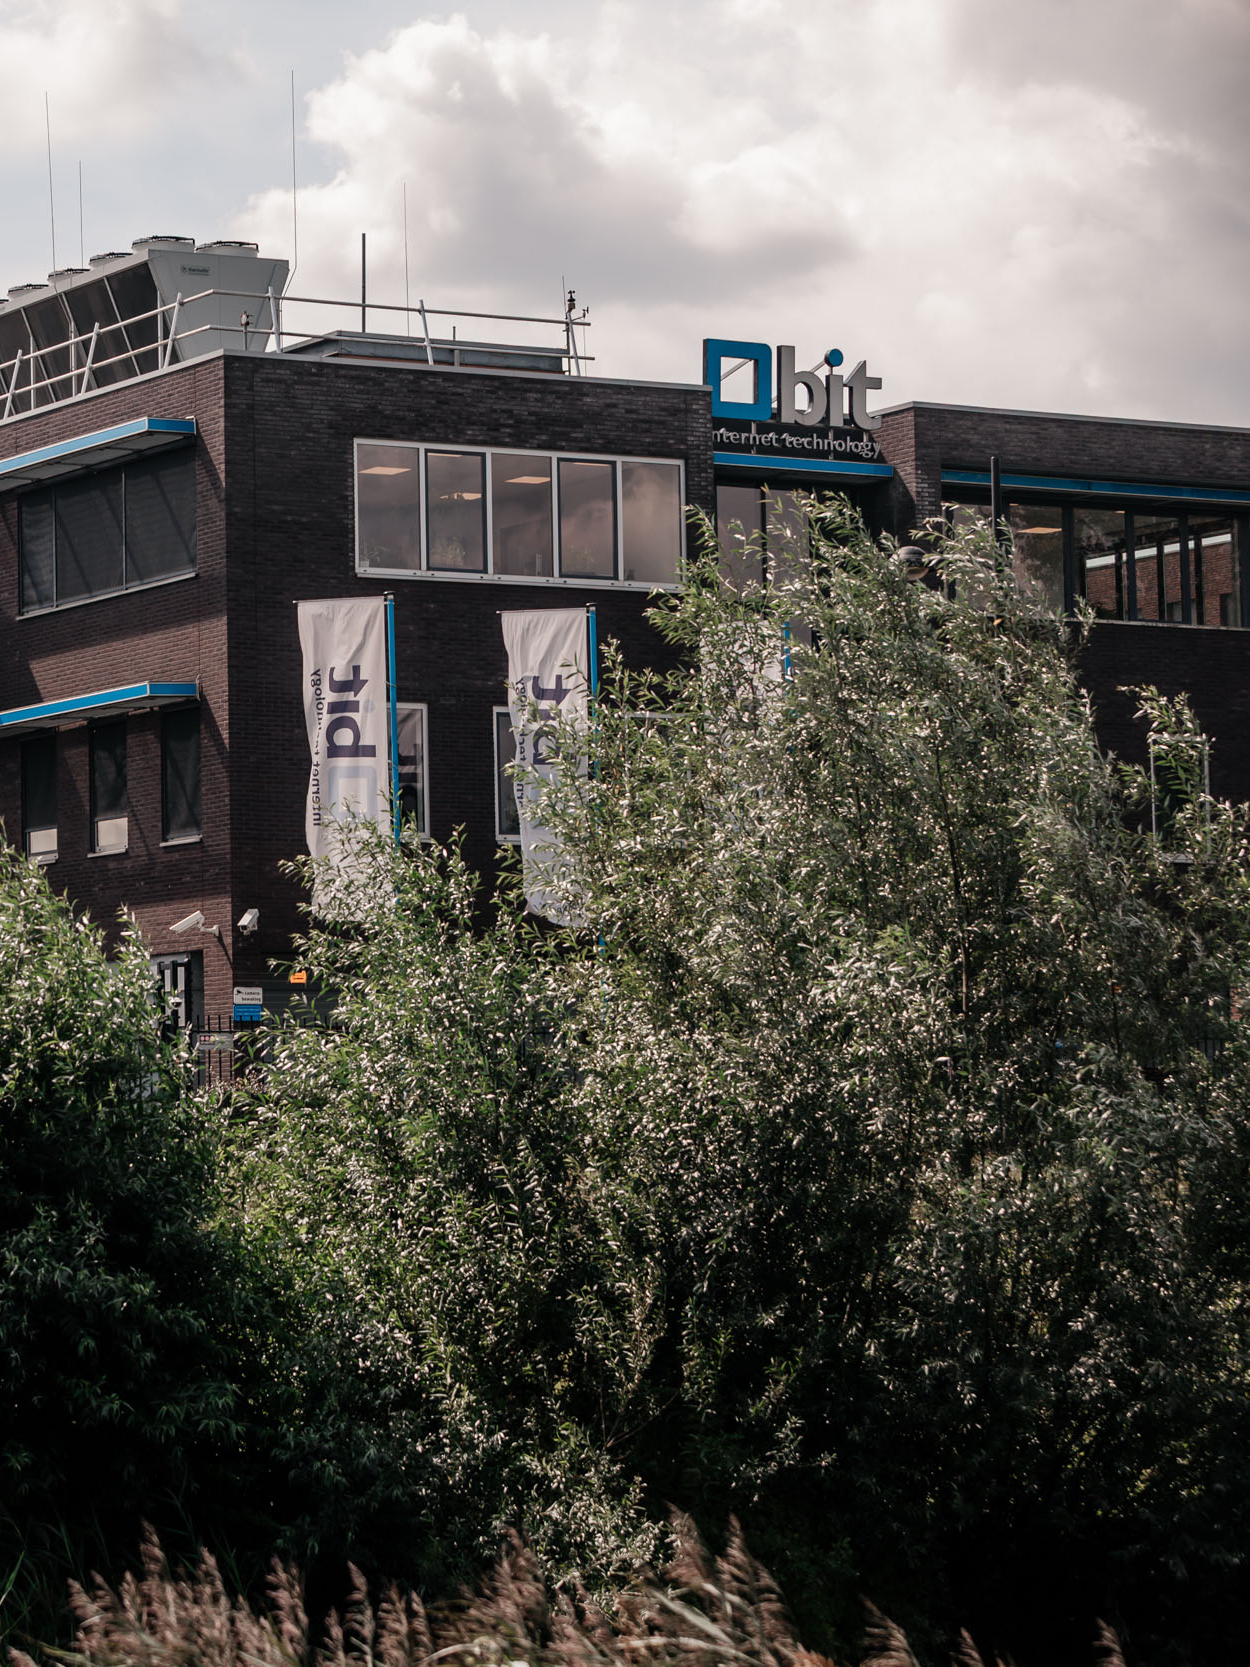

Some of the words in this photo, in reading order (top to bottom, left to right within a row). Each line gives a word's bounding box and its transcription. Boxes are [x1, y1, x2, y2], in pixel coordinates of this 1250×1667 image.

[777, 345, 882, 430] bit
[712, 428, 779, 447] nternet
[781, 433, 882, 459] technology
